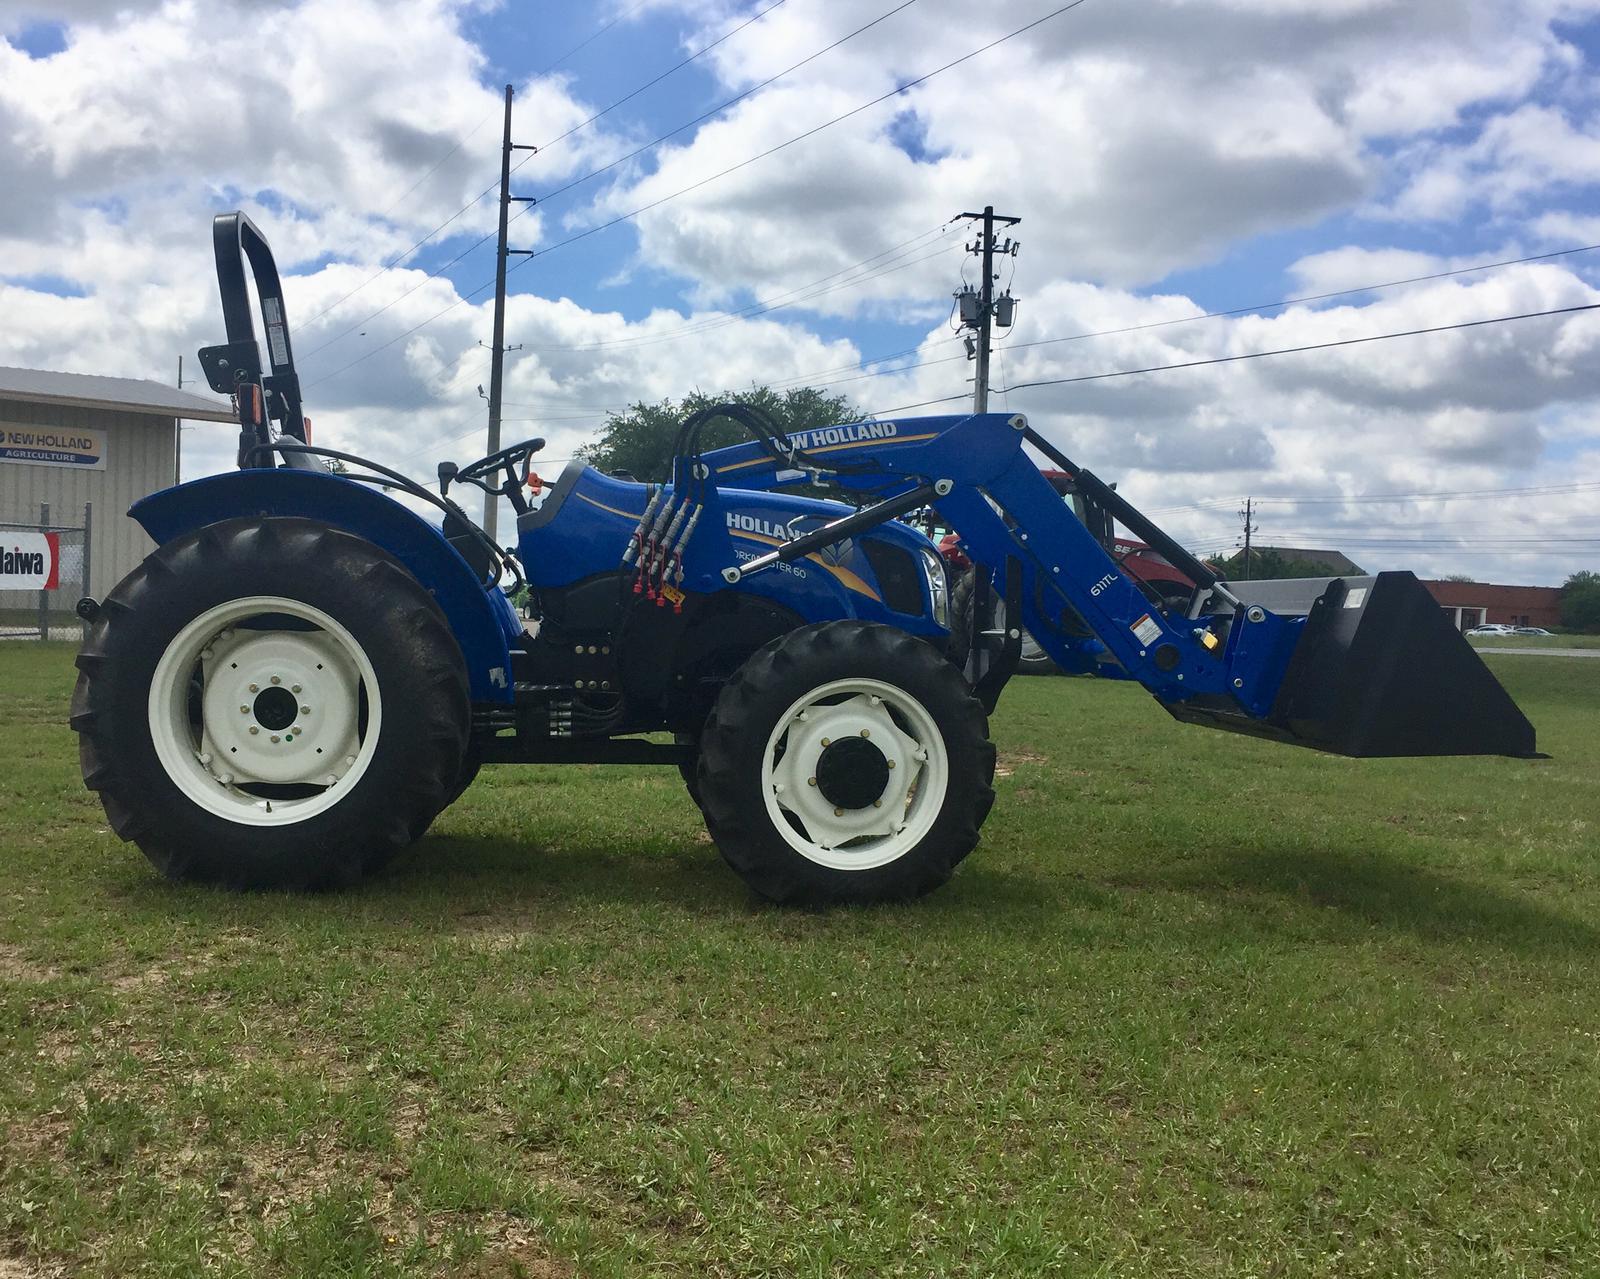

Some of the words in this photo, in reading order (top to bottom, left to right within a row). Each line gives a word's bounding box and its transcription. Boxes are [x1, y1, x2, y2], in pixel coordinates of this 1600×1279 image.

[8, 432, 34, 445] NEW
[36, 435, 92, 450] HOLLAND
[811, 422, 897, 446] HOLLAND
[5, 449, 76, 462] AGRICULTURE
[793, 567, 807, 579] 60
